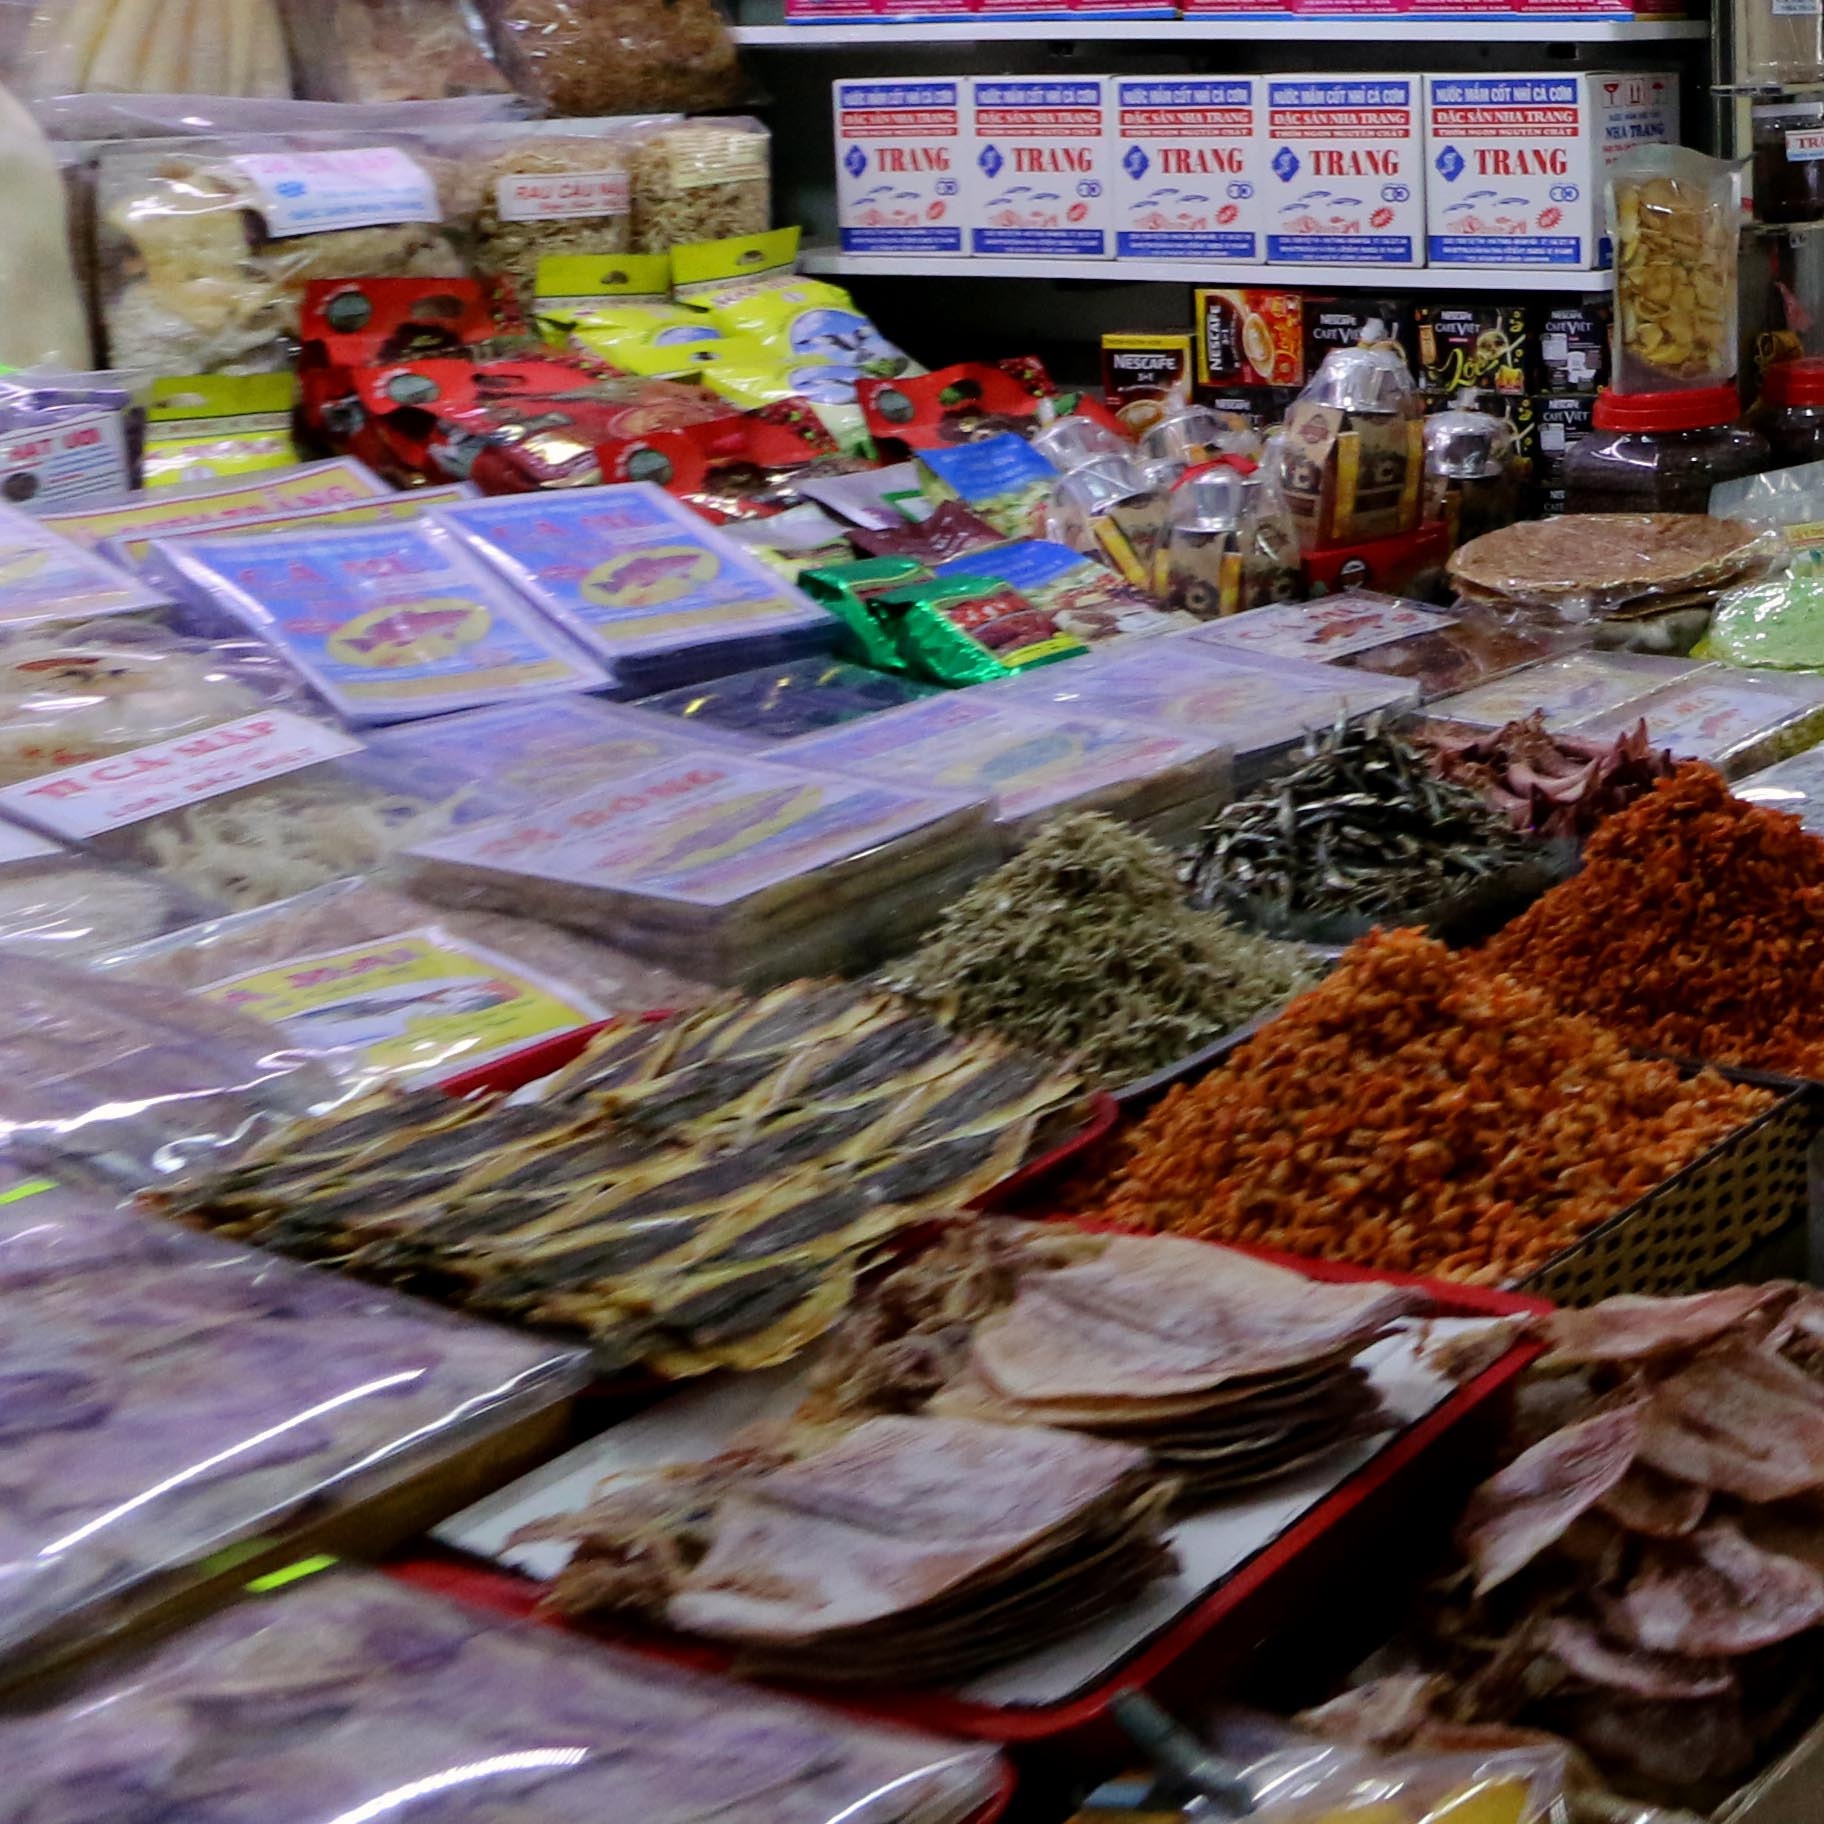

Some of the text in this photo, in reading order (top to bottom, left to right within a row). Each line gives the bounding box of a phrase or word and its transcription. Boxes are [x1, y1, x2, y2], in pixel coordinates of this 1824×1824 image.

[874, 147, 951, 173] TRANG
[1010, 147, 1093, 174] TRANG
[1158, 147, 1243, 175] TRANG
[1308, 148, 1401, 177] TRANG
[1473, 148, 1568, 177] TRANG
